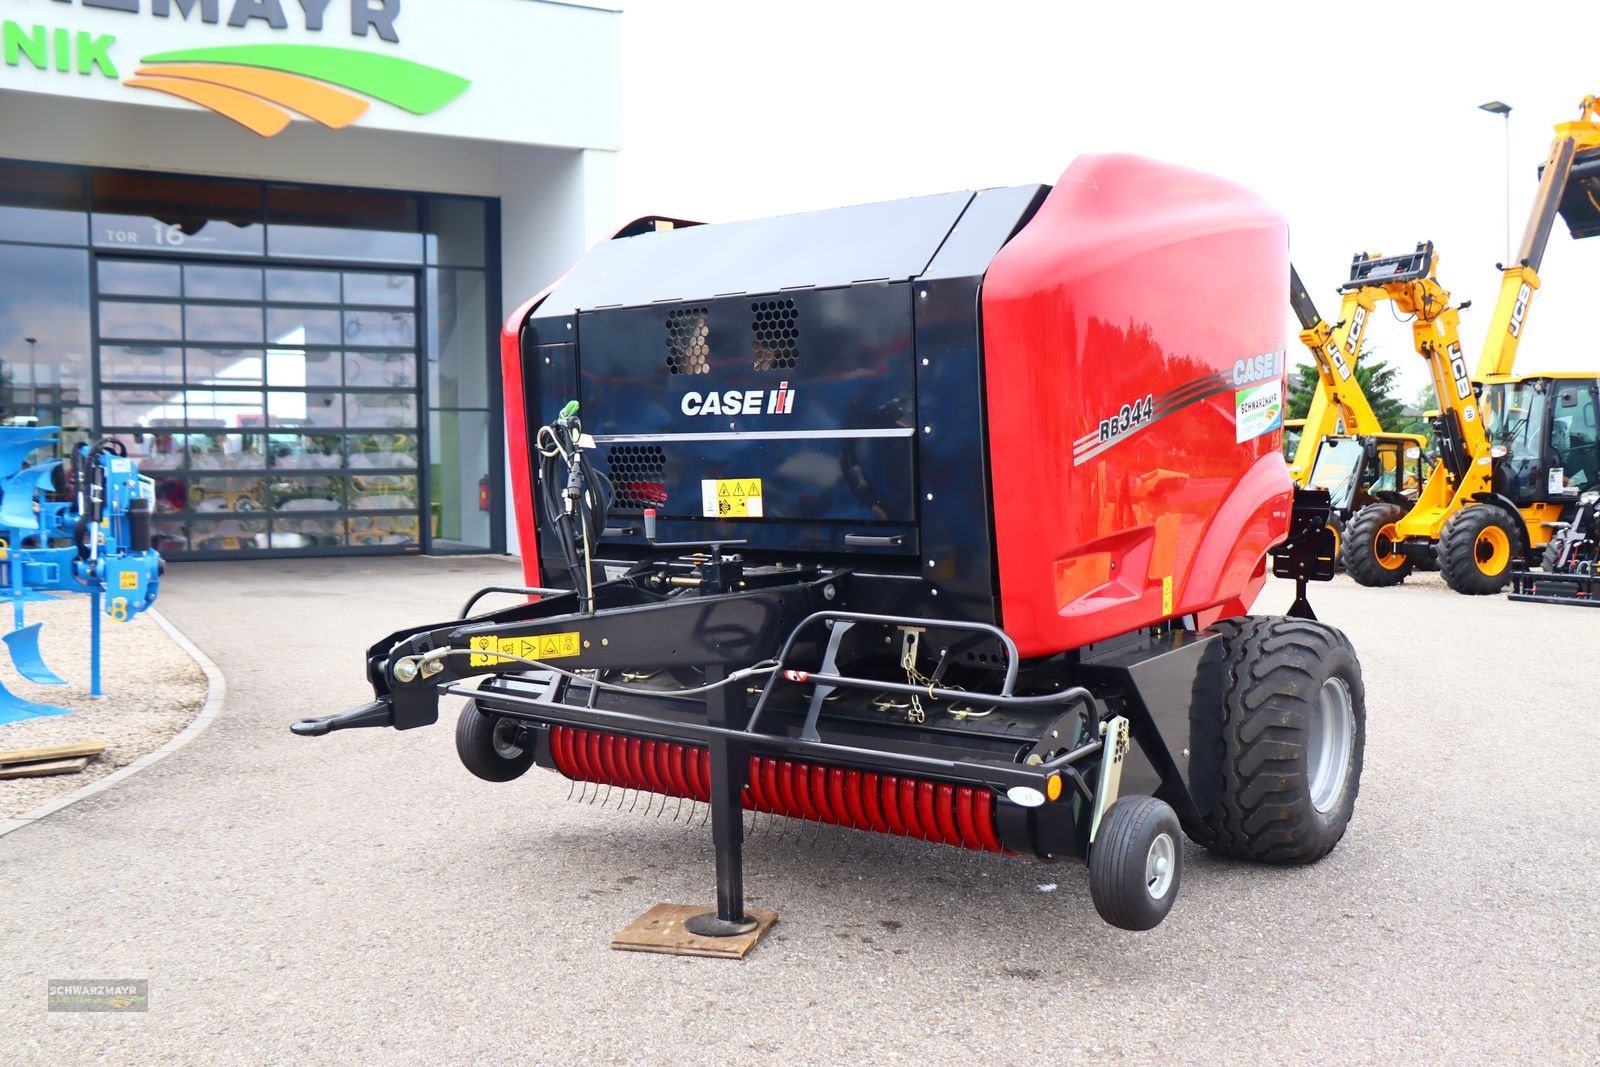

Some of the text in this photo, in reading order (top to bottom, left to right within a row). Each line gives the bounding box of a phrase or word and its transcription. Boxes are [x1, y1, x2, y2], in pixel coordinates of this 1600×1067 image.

[3, 19, 119, 79] NIK
[106, 222, 185, 246] TOR 16
[1345, 305, 1366, 355] JCB
[1508, 282, 1531, 338] JCB
[1234, 353, 1273, 385] CASE
[1326, 339, 1350, 381] JCB
[1447, 341, 1471, 400] JCB
[681, 390, 764, 416] CASE
[1099, 394, 1153, 442] RB344
